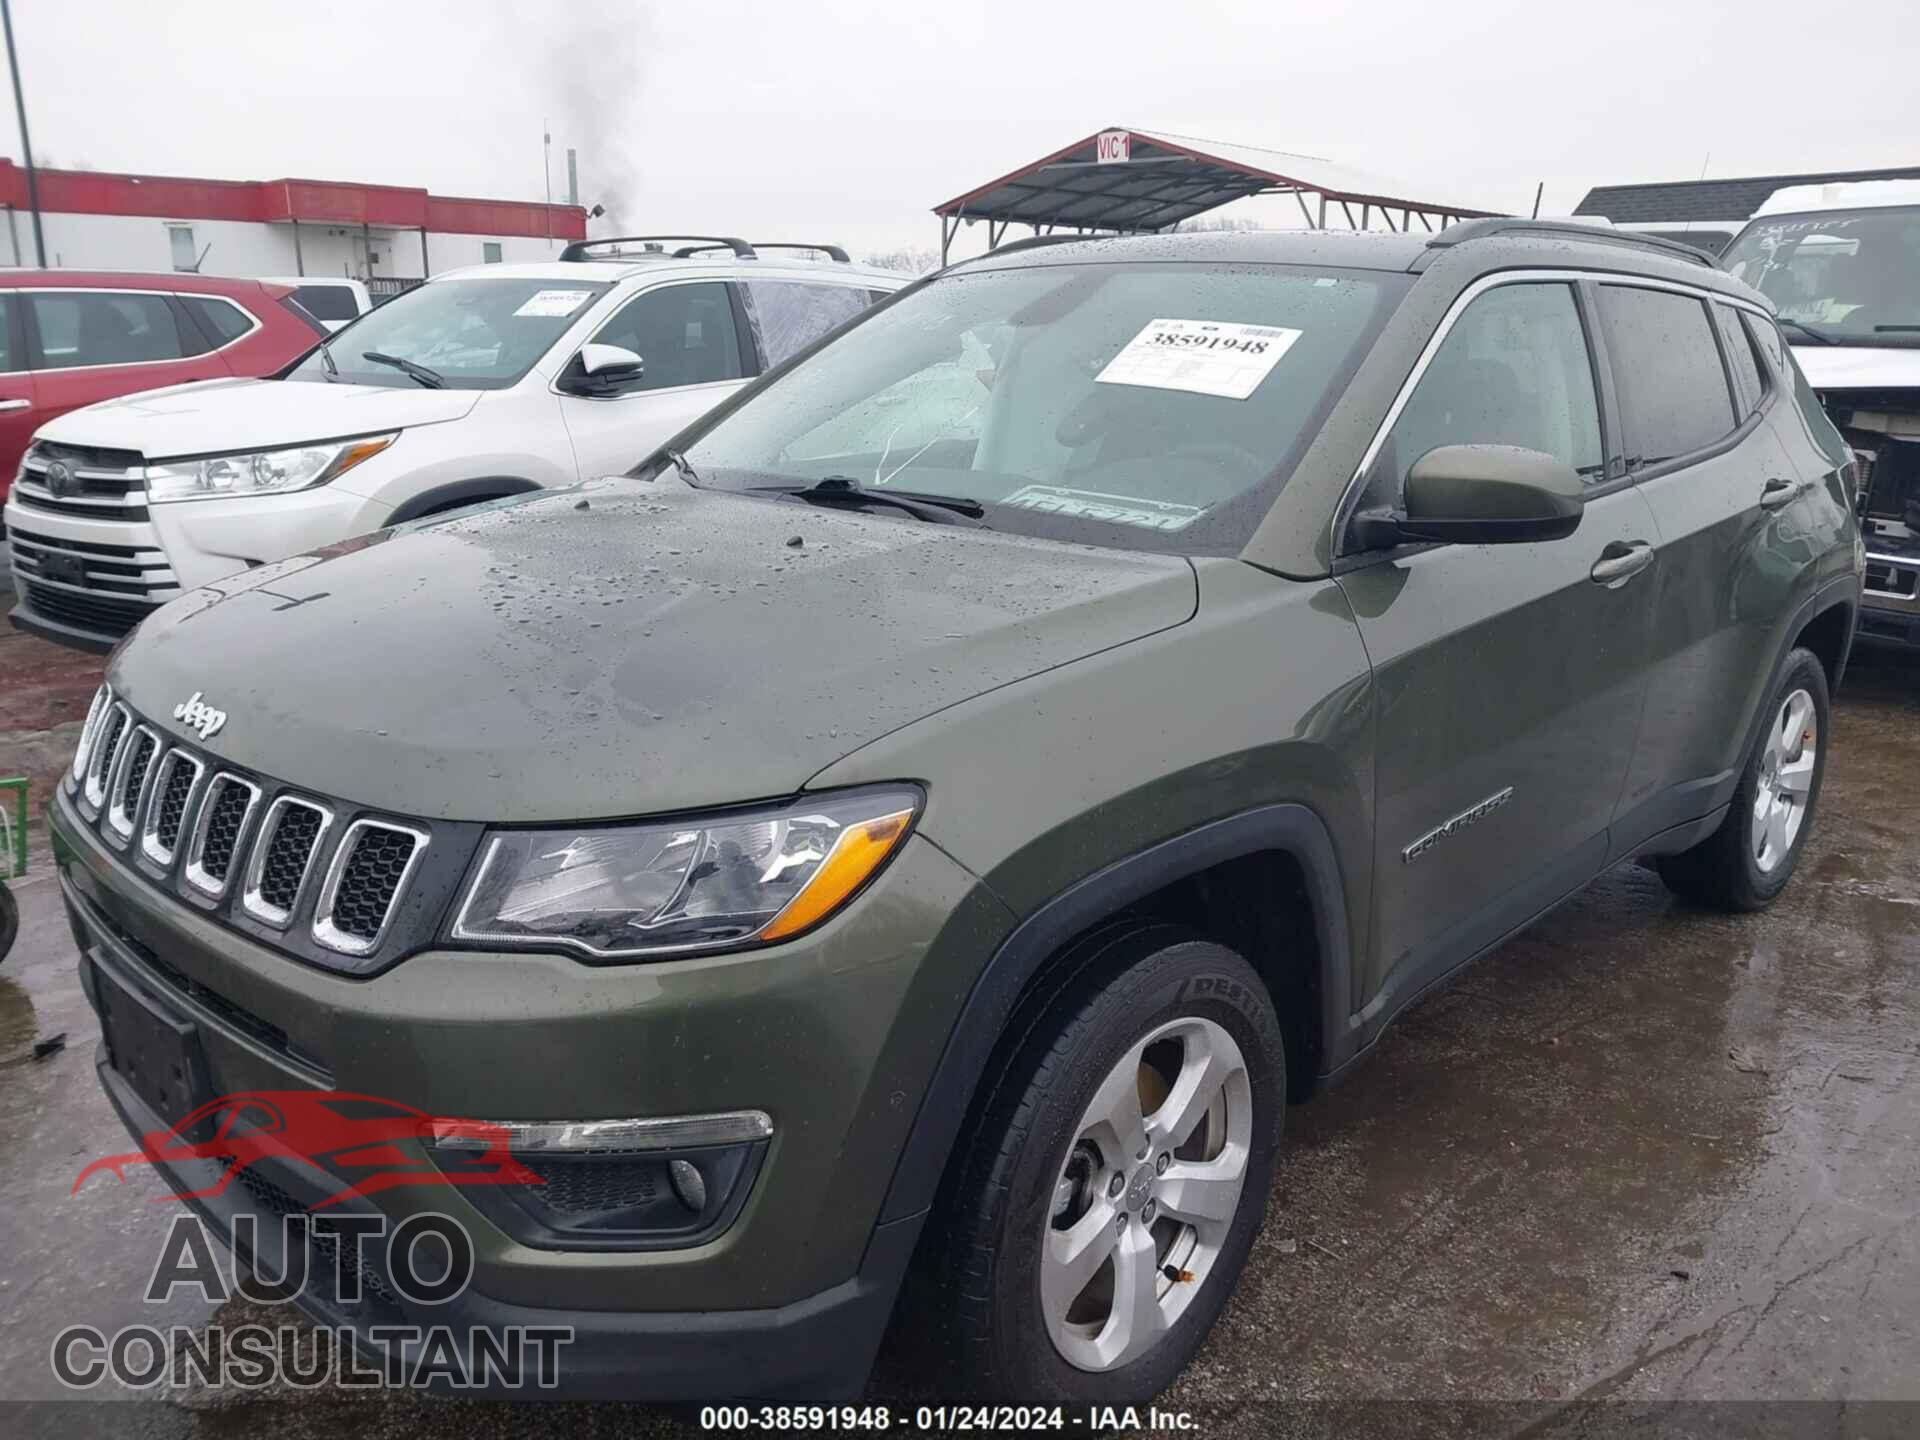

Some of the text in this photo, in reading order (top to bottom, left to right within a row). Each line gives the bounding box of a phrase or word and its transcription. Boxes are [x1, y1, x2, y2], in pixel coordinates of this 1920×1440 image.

[1098, 135, 1129, 159] VIC 1
[1146, 332, 1270, 355] 38591948
[173, 691, 227, 740] Jeep
